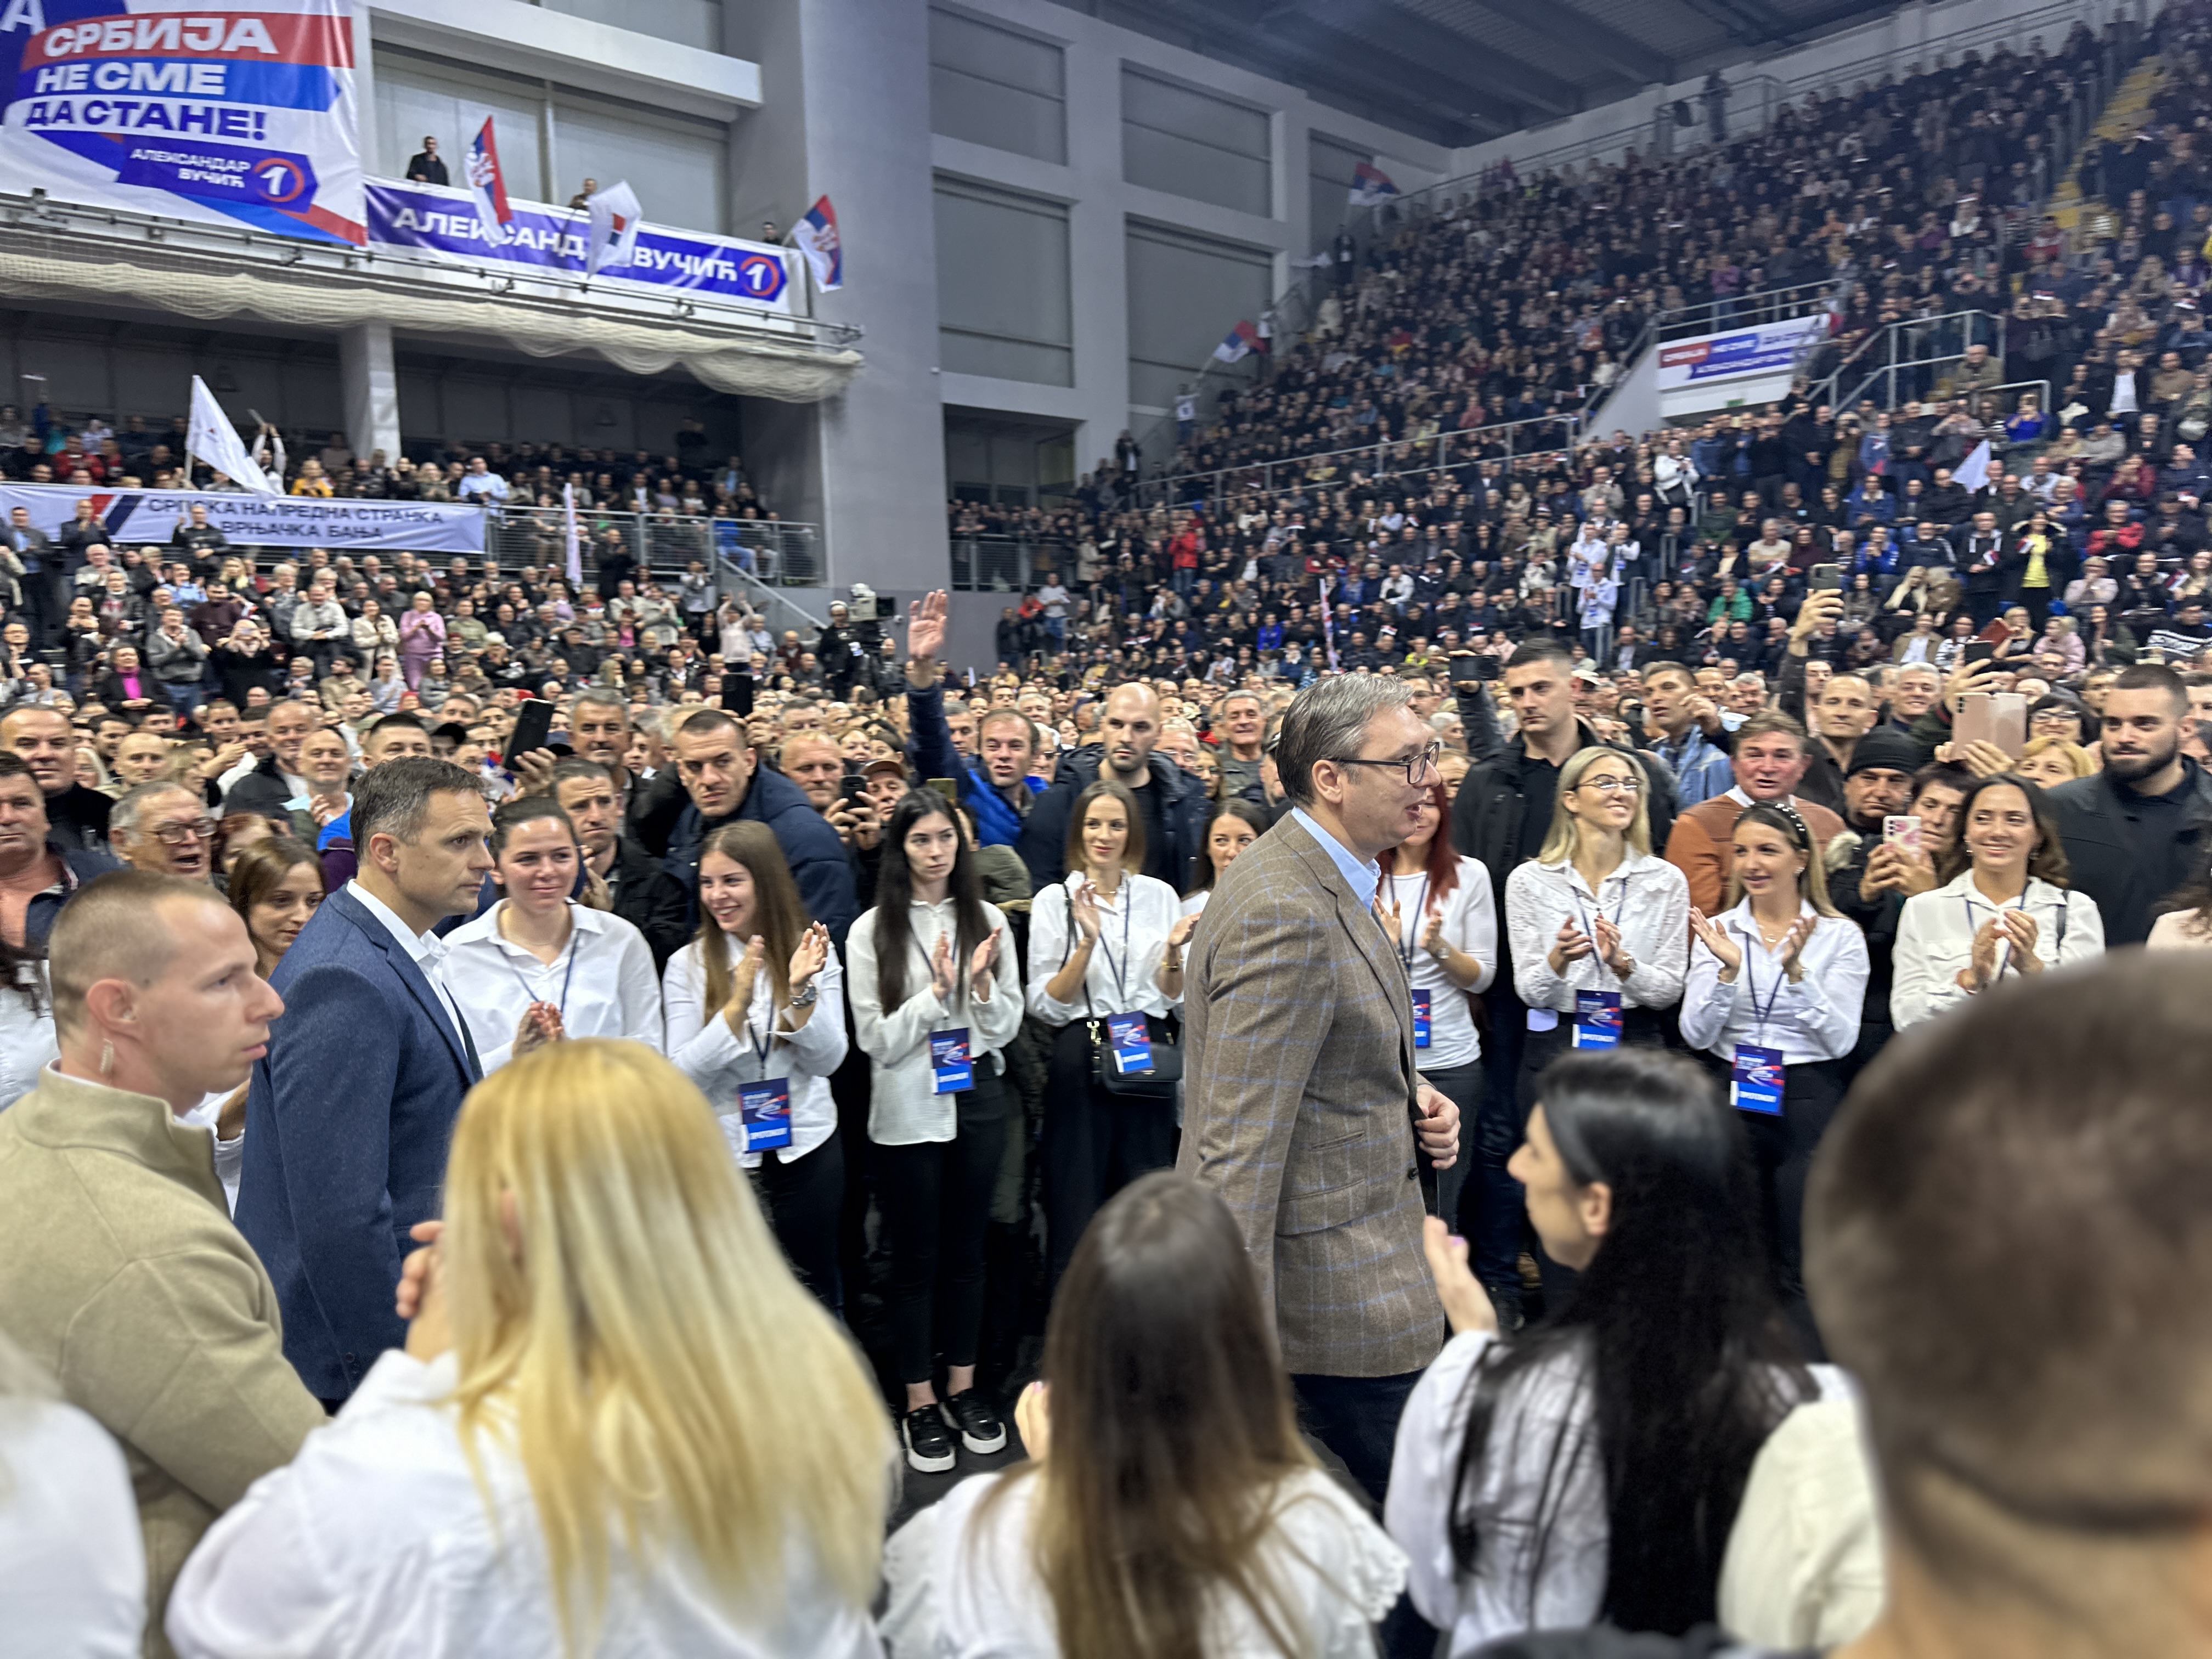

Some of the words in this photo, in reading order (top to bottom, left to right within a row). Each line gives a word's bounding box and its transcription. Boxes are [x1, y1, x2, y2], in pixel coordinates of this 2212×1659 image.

[43, 18, 279, 57] СРБИЈА
[34, 63, 91, 93] НЕ
[93, 61, 227, 95] СМЕ
[23, 100, 75, 127] ДА
[82, 100, 268, 141] СТАНЕ!
[259, 166, 288, 196] 1
[633, 246, 738, 281] ВУЧИЋ
[746, 263, 767, 291] 1
